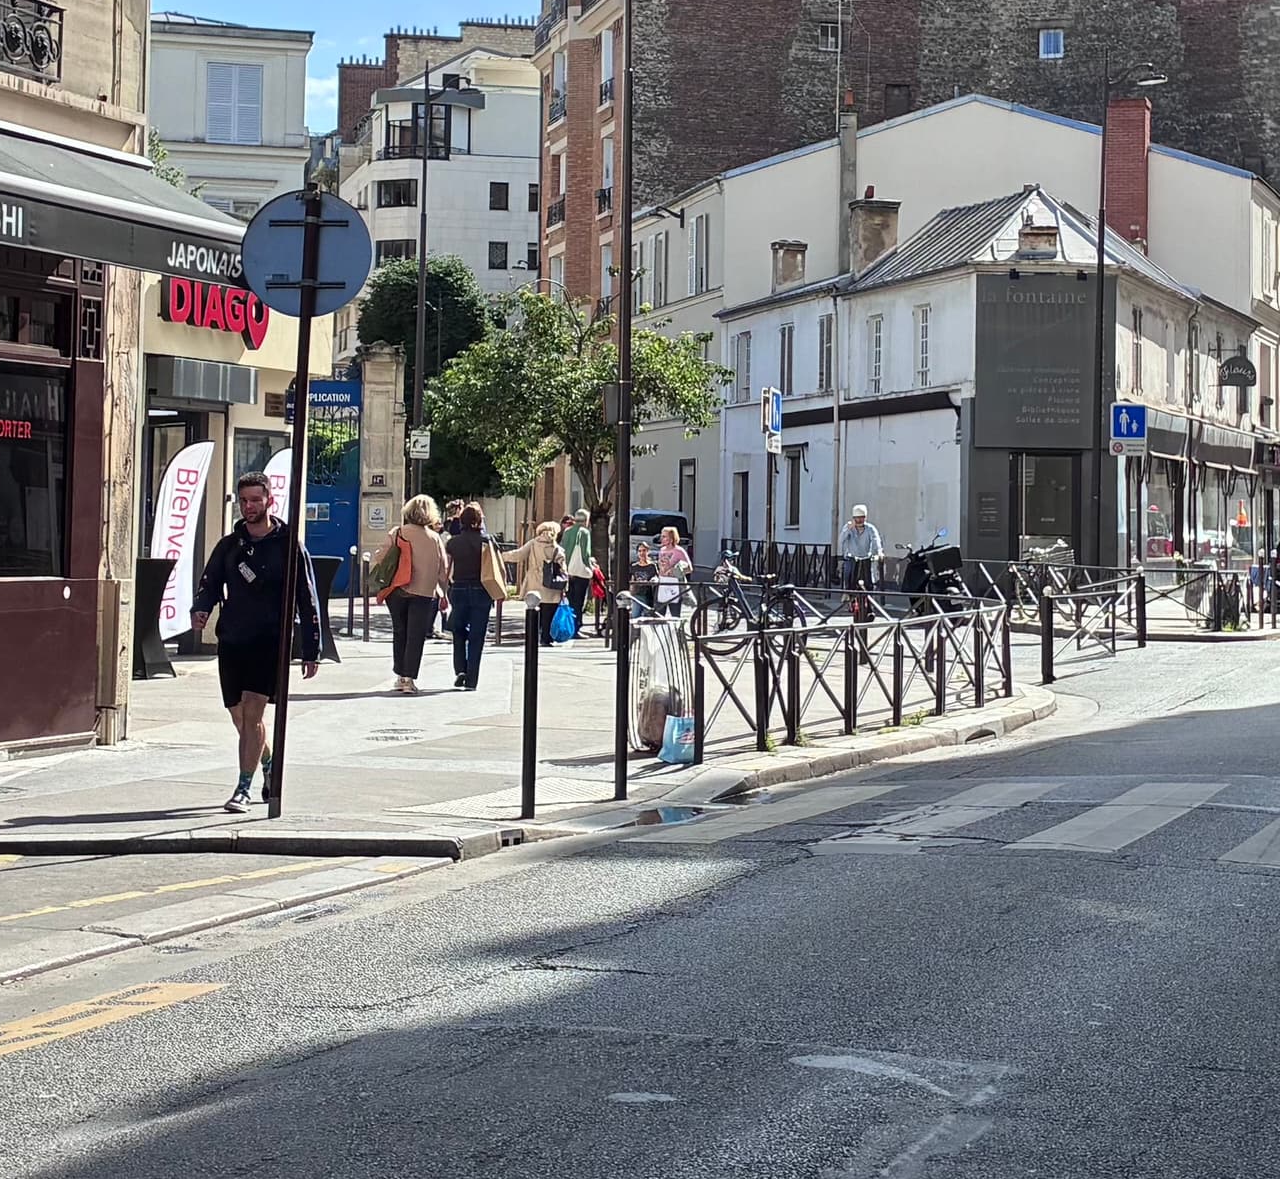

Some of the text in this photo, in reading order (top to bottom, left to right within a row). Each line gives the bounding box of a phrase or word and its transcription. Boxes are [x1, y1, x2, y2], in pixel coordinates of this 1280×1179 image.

[166, 240, 243, 279] JAPONAIS
[1006, 284, 1088, 304] fontaine
[308, 393, 351, 403] PLICATION
